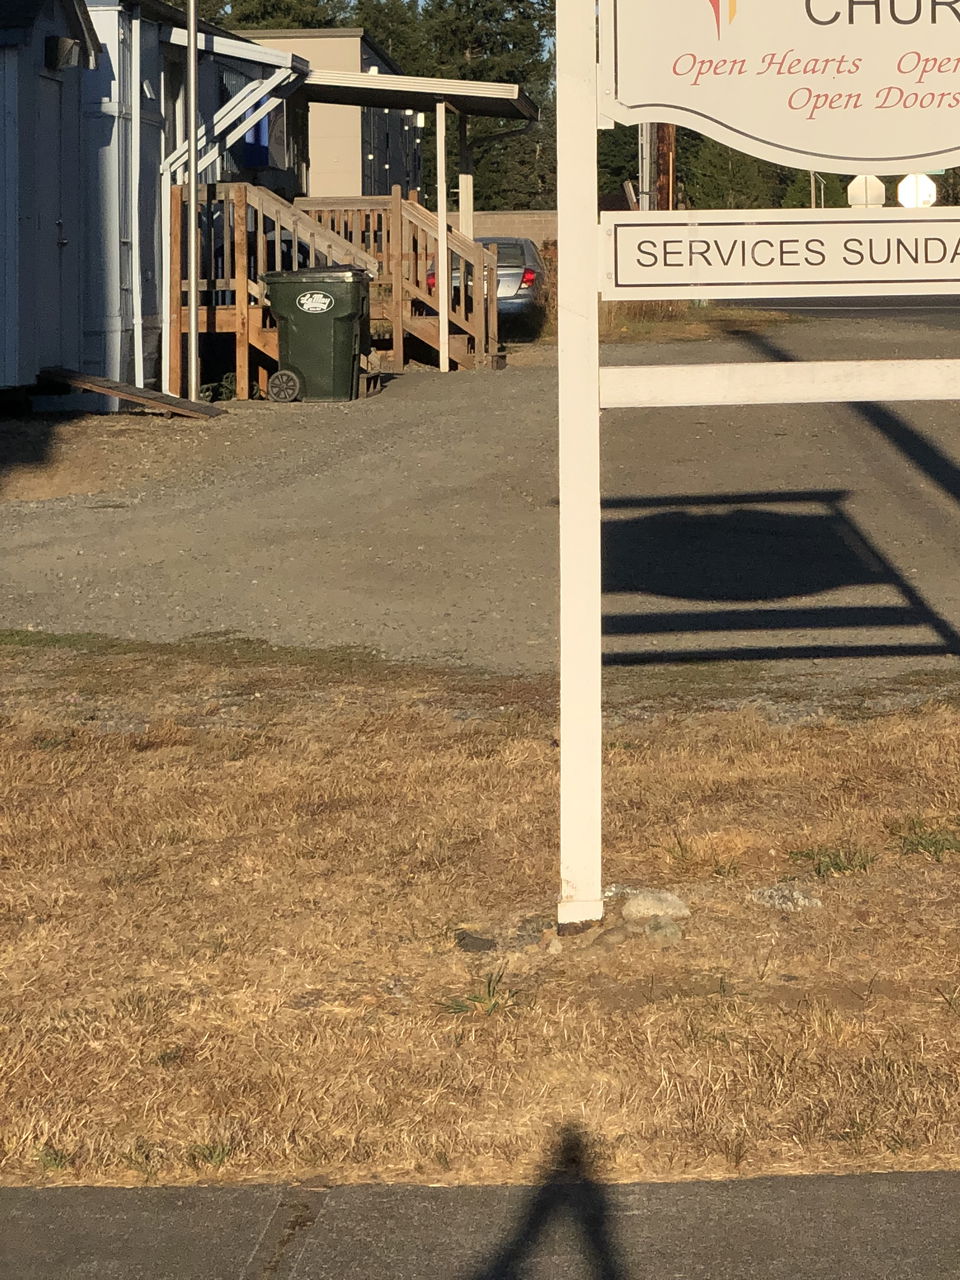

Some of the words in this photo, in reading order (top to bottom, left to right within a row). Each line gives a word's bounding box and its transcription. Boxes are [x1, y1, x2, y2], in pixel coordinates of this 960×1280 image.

[672, 53, 747, 86] Open
[756, 49, 863, 76] Hearts
[787, 87, 863, 120] Open
[636, 238, 826, 268] SERVICES
